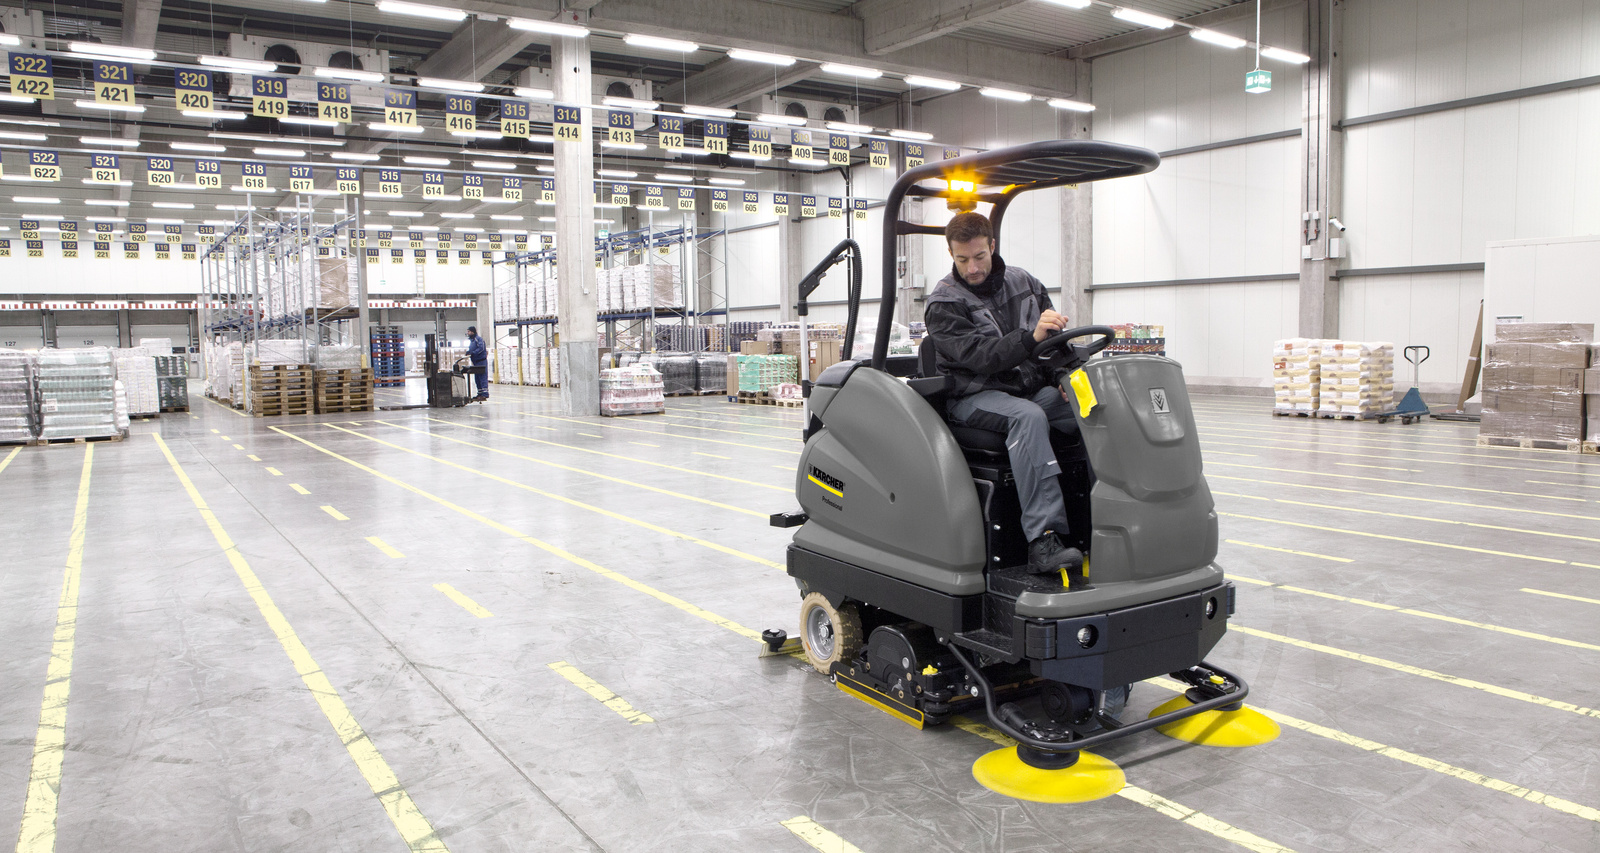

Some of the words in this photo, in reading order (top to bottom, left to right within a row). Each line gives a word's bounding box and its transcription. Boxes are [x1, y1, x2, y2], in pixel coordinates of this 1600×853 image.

[14, 56, 47, 74] 322
[100, 65, 128, 81] 321
[179, 72, 208, 88] 320
[17, 79, 49, 96] 422
[256, 80, 283, 94] 319
[101, 86, 129, 102] 421
[322, 85, 347, 100] 318
[181, 93, 208, 109] 420
[388, 91, 412, 105] 317
[258, 100, 284, 115] 419
[449, 98, 472, 112] 316
[504, 104, 526, 116] 315
[323, 105, 348, 119] 418
[389, 110, 412, 124] 417
[557, 108, 578, 121] 314
[450, 117, 472, 130] 416
[612, 113, 631, 126] 313
[504, 122, 526, 135] 415
[662, 119, 680, 131] 312
[707, 124, 724, 135] 311
[558, 126, 578, 139] 414
[612, 130, 631, 142] 413
[752, 128, 768, 139] 310
[794, 132, 809, 143] 309
[662, 136, 681, 147] 412
[707, 140, 724, 151] 411
[832, 136, 847, 147] 308
[872, 141, 886, 151] 307
[752, 144, 769, 155] 410
[795, 148, 810, 158] 409
[908, 145, 922, 156] 306
[33, 153, 55, 164] 522
[96, 156, 115, 166] 521
[832, 152, 847, 162] 408
[872, 156, 887, 166] 407
[150, 159, 170, 169] 520
[198, 162, 218, 172] 519
[245, 164, 263, 174] 518
[34, 168, 56, 178] 622
[96, 171, 116, 181] 621
[292, 167, 309, 177] 517
[339, 169, 356, 179] 516
[382, 171, 398, 180] 515
[152, 173, 171, 183] 620
[199, 176, 218, 186] 619
[245, 178, 264, 188] 618
[425, 174, 441, 183] 514
[466, 176, 481, 185] 513
[505, 179, 520, 187] 512
[293, 180, 310, 189] 617
[340, 182, 357, 191] 616
[382, 184, 399, 193] 615
[544, 180, 554, 189] 51
[614, 185, 627, 193] 509
[426, 186, 441, 195] 614
[466, 188, 481, 197] 613
[505, 191, 520, 199] 612
[648, 187, 661, 195] 508
[680, 189, 692, 197] 507
[648, 199, 661, 207] 608
